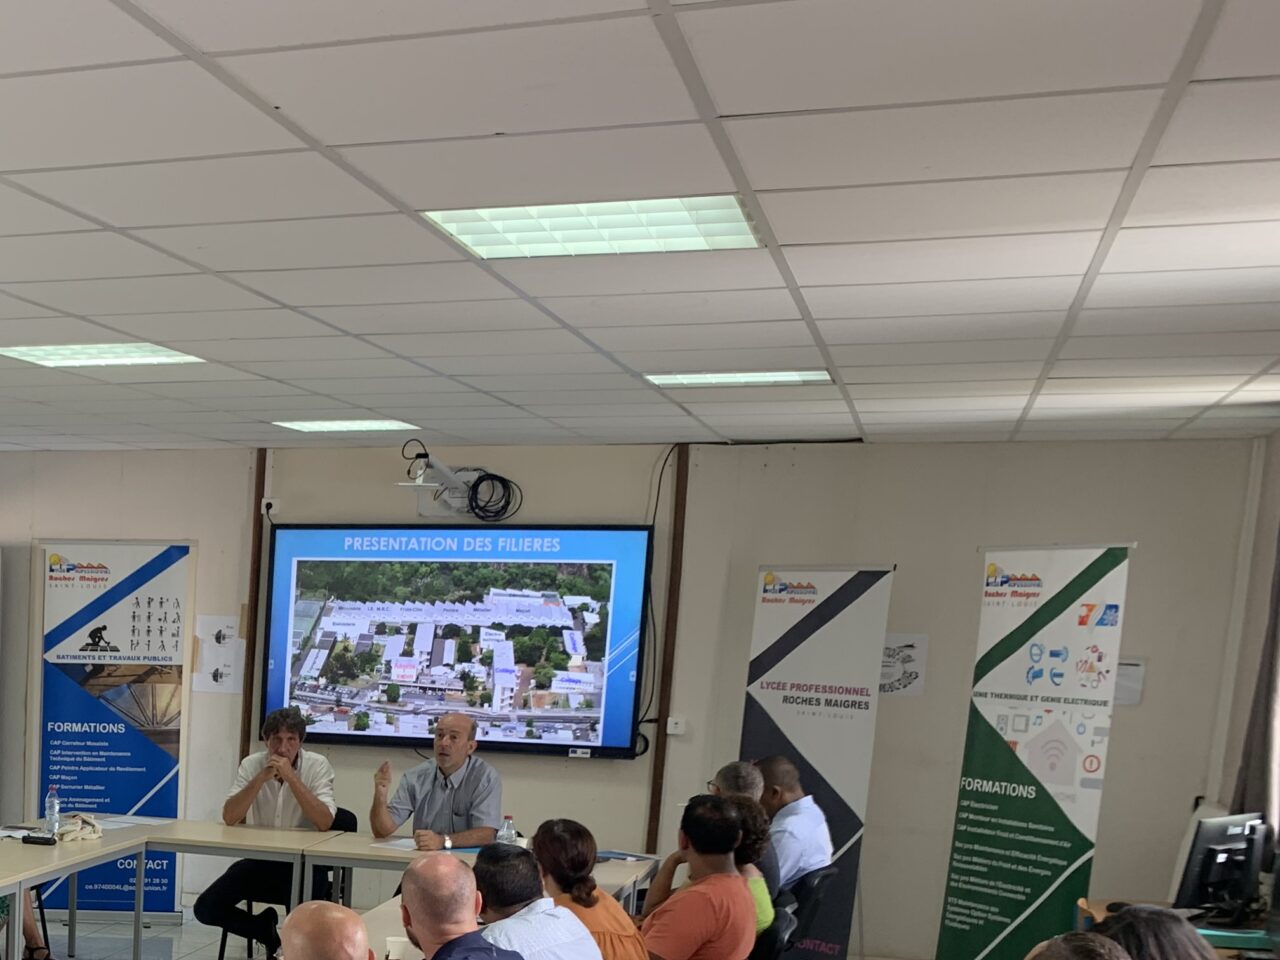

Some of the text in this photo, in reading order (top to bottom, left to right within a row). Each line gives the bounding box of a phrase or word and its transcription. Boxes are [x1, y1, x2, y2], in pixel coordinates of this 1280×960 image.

[344, 536, 561, 552] PRESENTATION DES FILIERES
[760, 681, 871, 696] LYCÉE PROFESSIONNEL
[782, 695, 870, 710] ROCHES MAIGRES
[1064, 697, 1110, 707] ELECTRIQUE
[47, 722, 126, 734] FORMATIONS
[960, 776, 1036, 799] FORMATIONS
